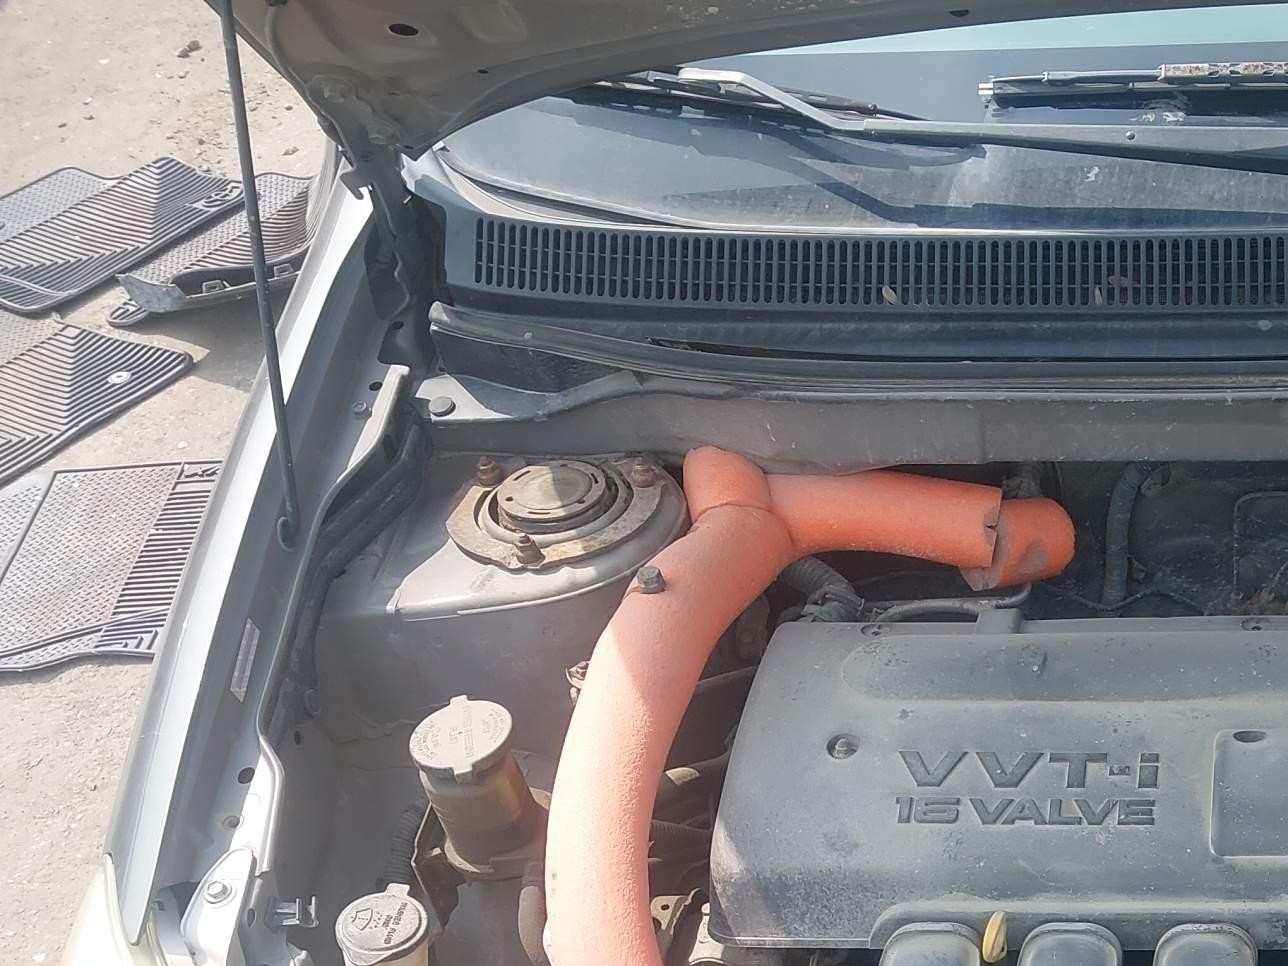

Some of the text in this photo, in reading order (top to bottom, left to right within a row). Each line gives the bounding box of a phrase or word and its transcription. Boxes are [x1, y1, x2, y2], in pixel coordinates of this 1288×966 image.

[898, 751, 1160, 789] VVT-i
[896, 796, 1157, 826] 16 VALVE
